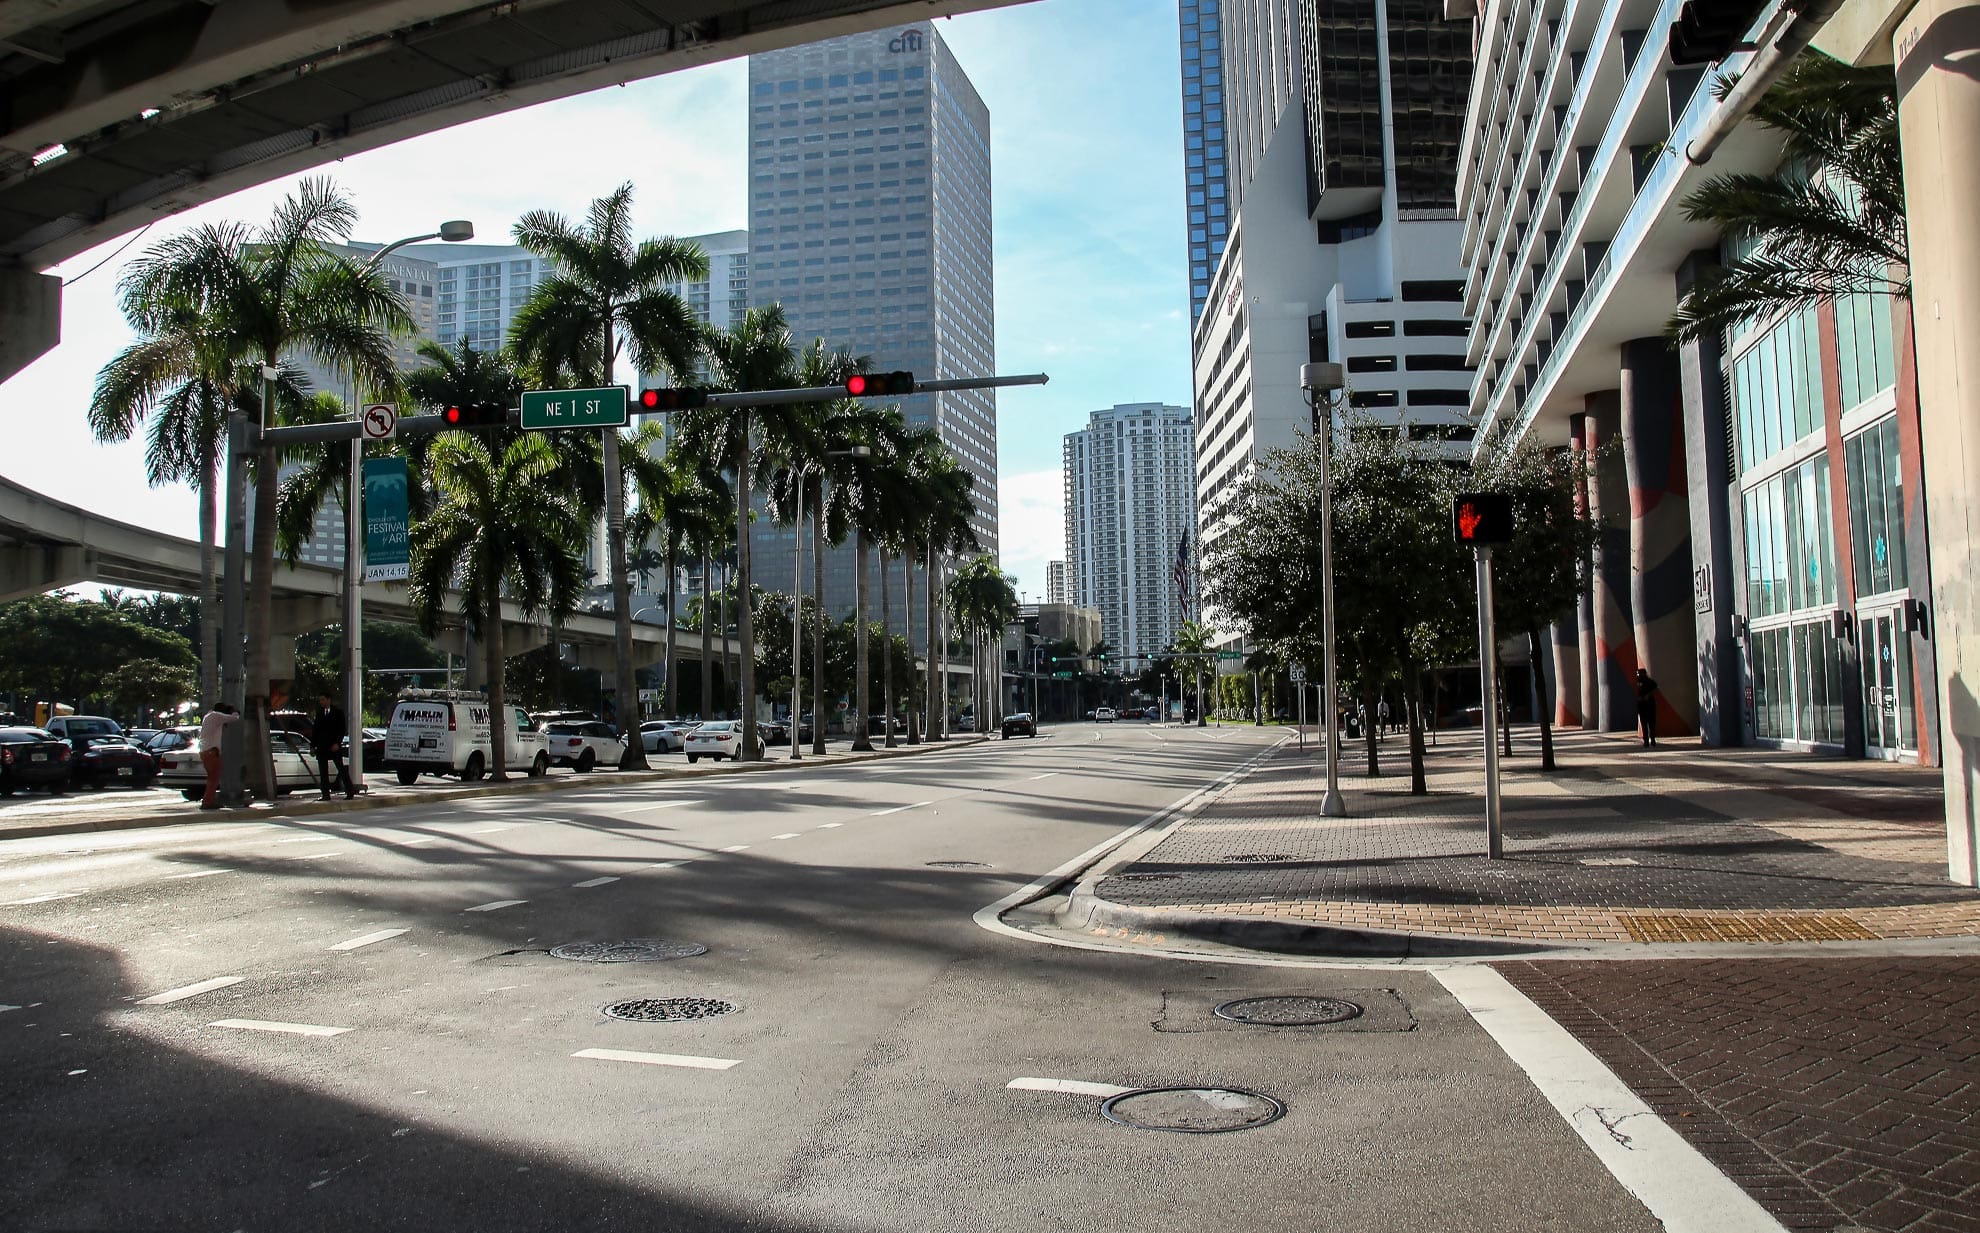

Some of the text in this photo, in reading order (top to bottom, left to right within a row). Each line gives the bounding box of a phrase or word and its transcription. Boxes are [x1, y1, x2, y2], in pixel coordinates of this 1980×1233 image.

[889, 31, 922, 53] citi
[546, 399, 601, 417] NE 1 ST
[368, 521, 407, 534] FESTIVAL
[388, 532, 407, 544] ART
[368, 568, 385, 578] JAN
[404, 710, 443, 721] MARLIN
